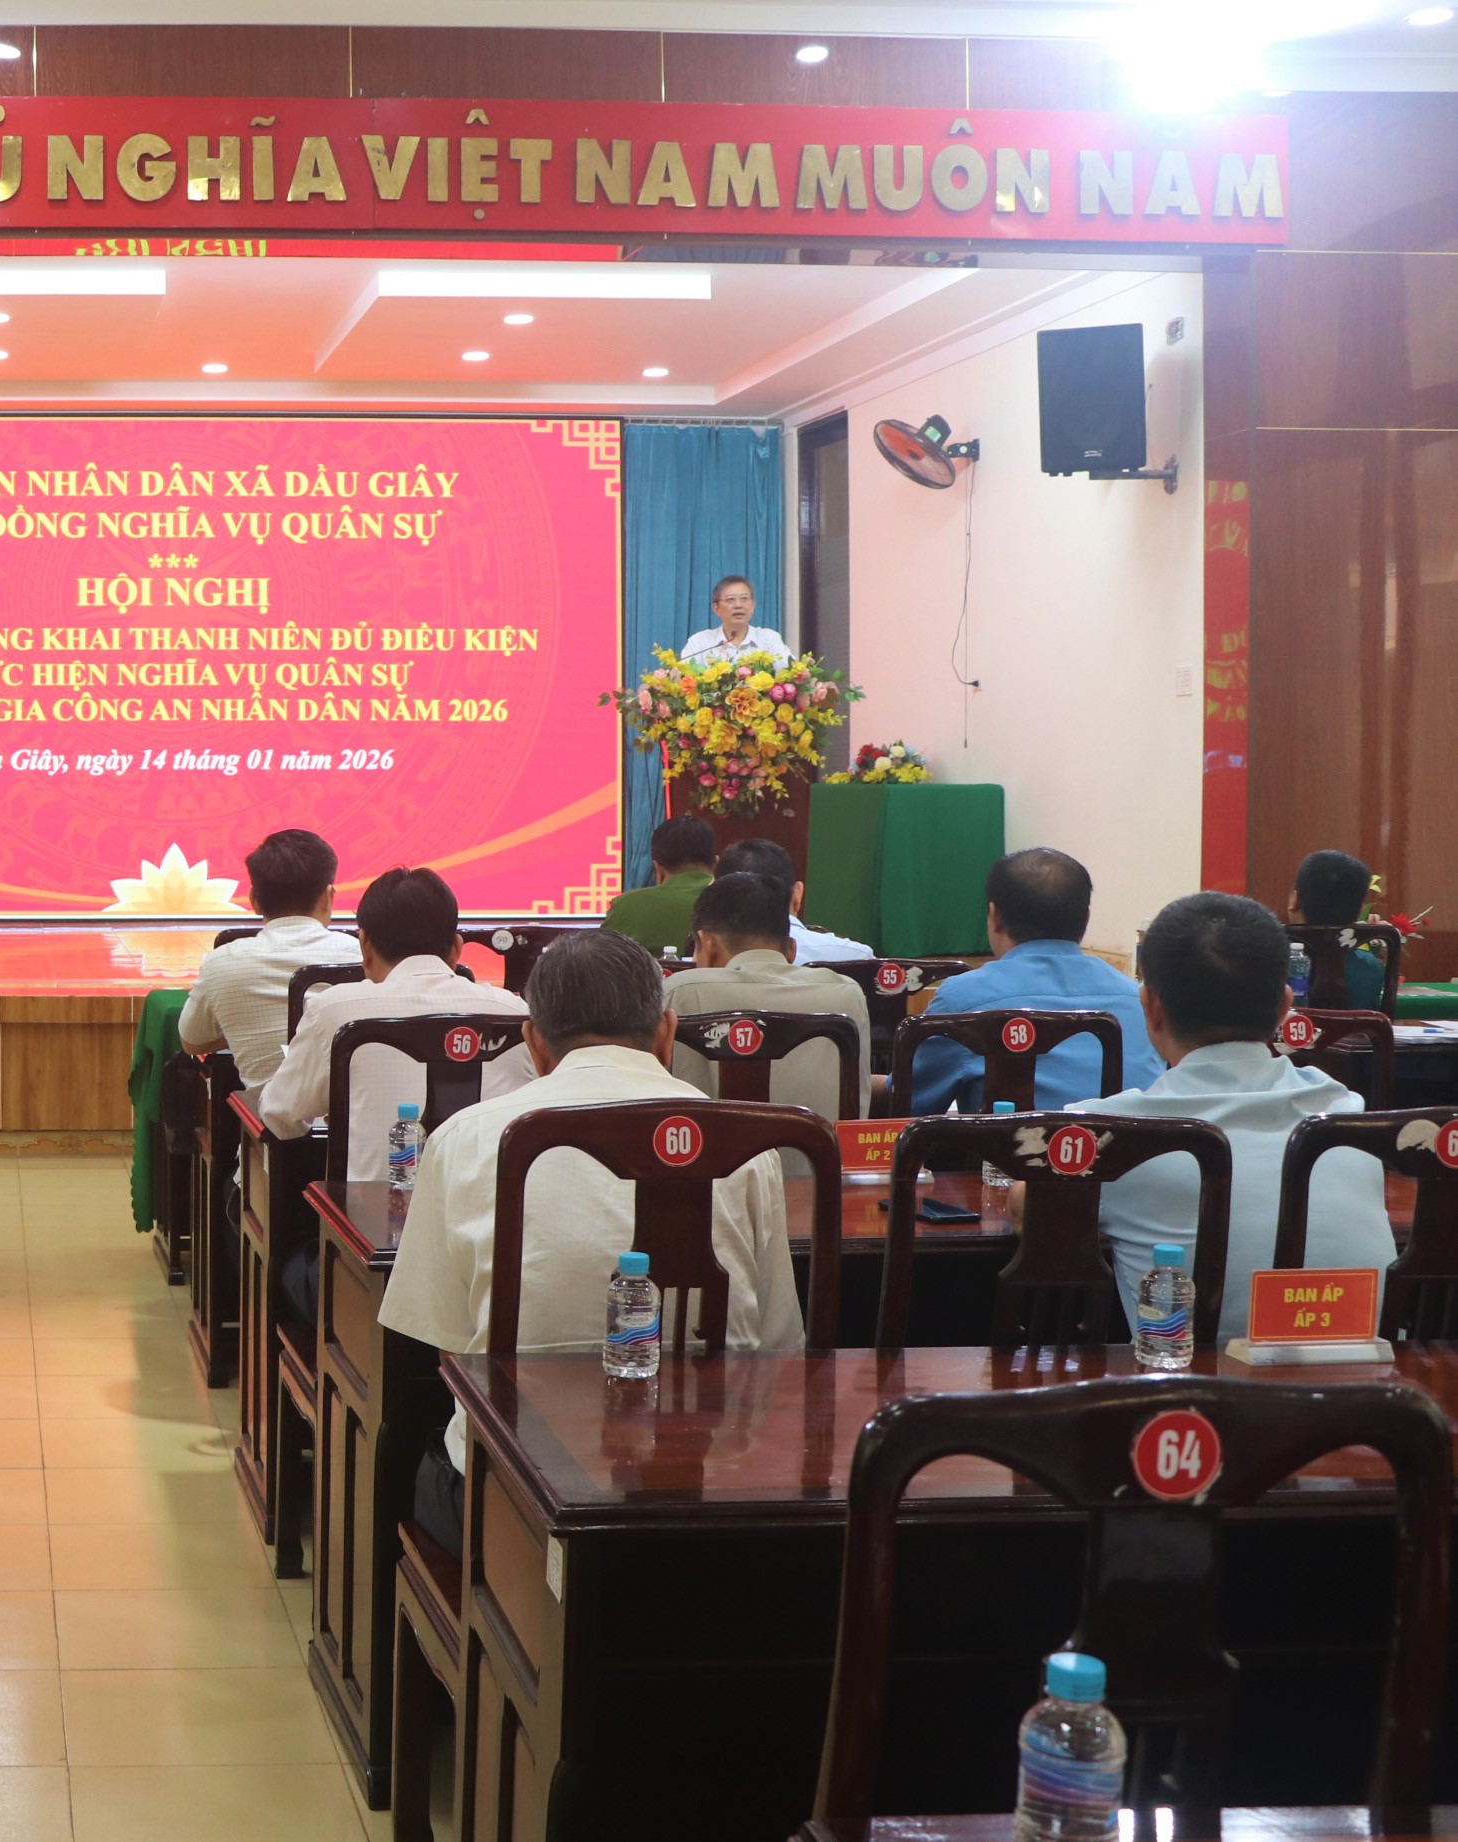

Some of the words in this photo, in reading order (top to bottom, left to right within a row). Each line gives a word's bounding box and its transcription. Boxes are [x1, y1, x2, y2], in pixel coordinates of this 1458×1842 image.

[47, 115, 347, 202] NGHĨA
[361, 108, 553, 220] VIỆT
[575, 138, 780, 208] NAM
[796, 118, 1049, 213] MUÔN
[1079, 127, 1283, 218] NĂM
[26, 462, 130, 497] NHÂN
[139, 461, 215, 497] DÂN
[224, 464, 275, 497] XÃ
[284, 463, 359, 498] DẦU
[368, 463, 459, 498] GIÂY
[97, 505, 215, 539] NGHĨA
[222, 512, 272, 545] VỤ
[281, 504, 384, 544] QUÂN
[393, 509, 443, 546] SỰ
[76, 572, 153, 615] HỘI
[164, 577, 271, 615] NGHỊ
[42, 627, 121, 651] KHAI
[128, 627, 239, 651] THANH
[247, 620, 322, 651] NIÊN
[330, 621, 373, 651] ĐỦ
[381, 622, 455, 652] ĐIỀU
[464, 625, 538, 657] KIỆN
[32, 659, 108, 692] HIỆN
[117, 657, 219, 687] NGHĨA
[224, 663, 267, 692] VỤ
[275, 656, 363, 691] QUÂN
[371, 660, 414, 692] SỰ
[52, 691, 143, 722] CÔNG
[149, 698, 192, 721] AN
[201, 691, 289, 721] NHÂN
[298, 691, 361, 721] DÂN
[370, 693, 440, 722] NĂM
[448, 698, 508, 722] 2026
[10, 749, 69, 776] Giây,
[75, 748, 134, 776] ngày
[140, 749, 168, 770] 14
[172, 748, 241, 776] tháng
[246, 749, 274, 770] 01
[280, 750, 332, 770] năm
[337, 749, 394, 770] 2026
[882, 969, 898, 985] 55
[452, 1033, 472, 1055] 56
[735, 1026, 754, 1048] 57
[1009, 1024, 1028, 1045] 58
[1289, 1021, 1308, 1042] 59
[665, 1125, 692, 1155] 60
[858, 1132, 881, 1144] BAN
[1059, 1135, 1084, 1164] 61
[866, 1147, 881, 1161] ẤP
[883, 1150, 891, 1161] 2
[1284, 1287, 1318, 1303] BAN
[1322, 1282, 1344, 1302] ẤP
[1293, 1307, 1317, 1327] ẤP
[1320, 1312, 1331, 1327] 3
[1157, 1429, 1202, 1480] 64
